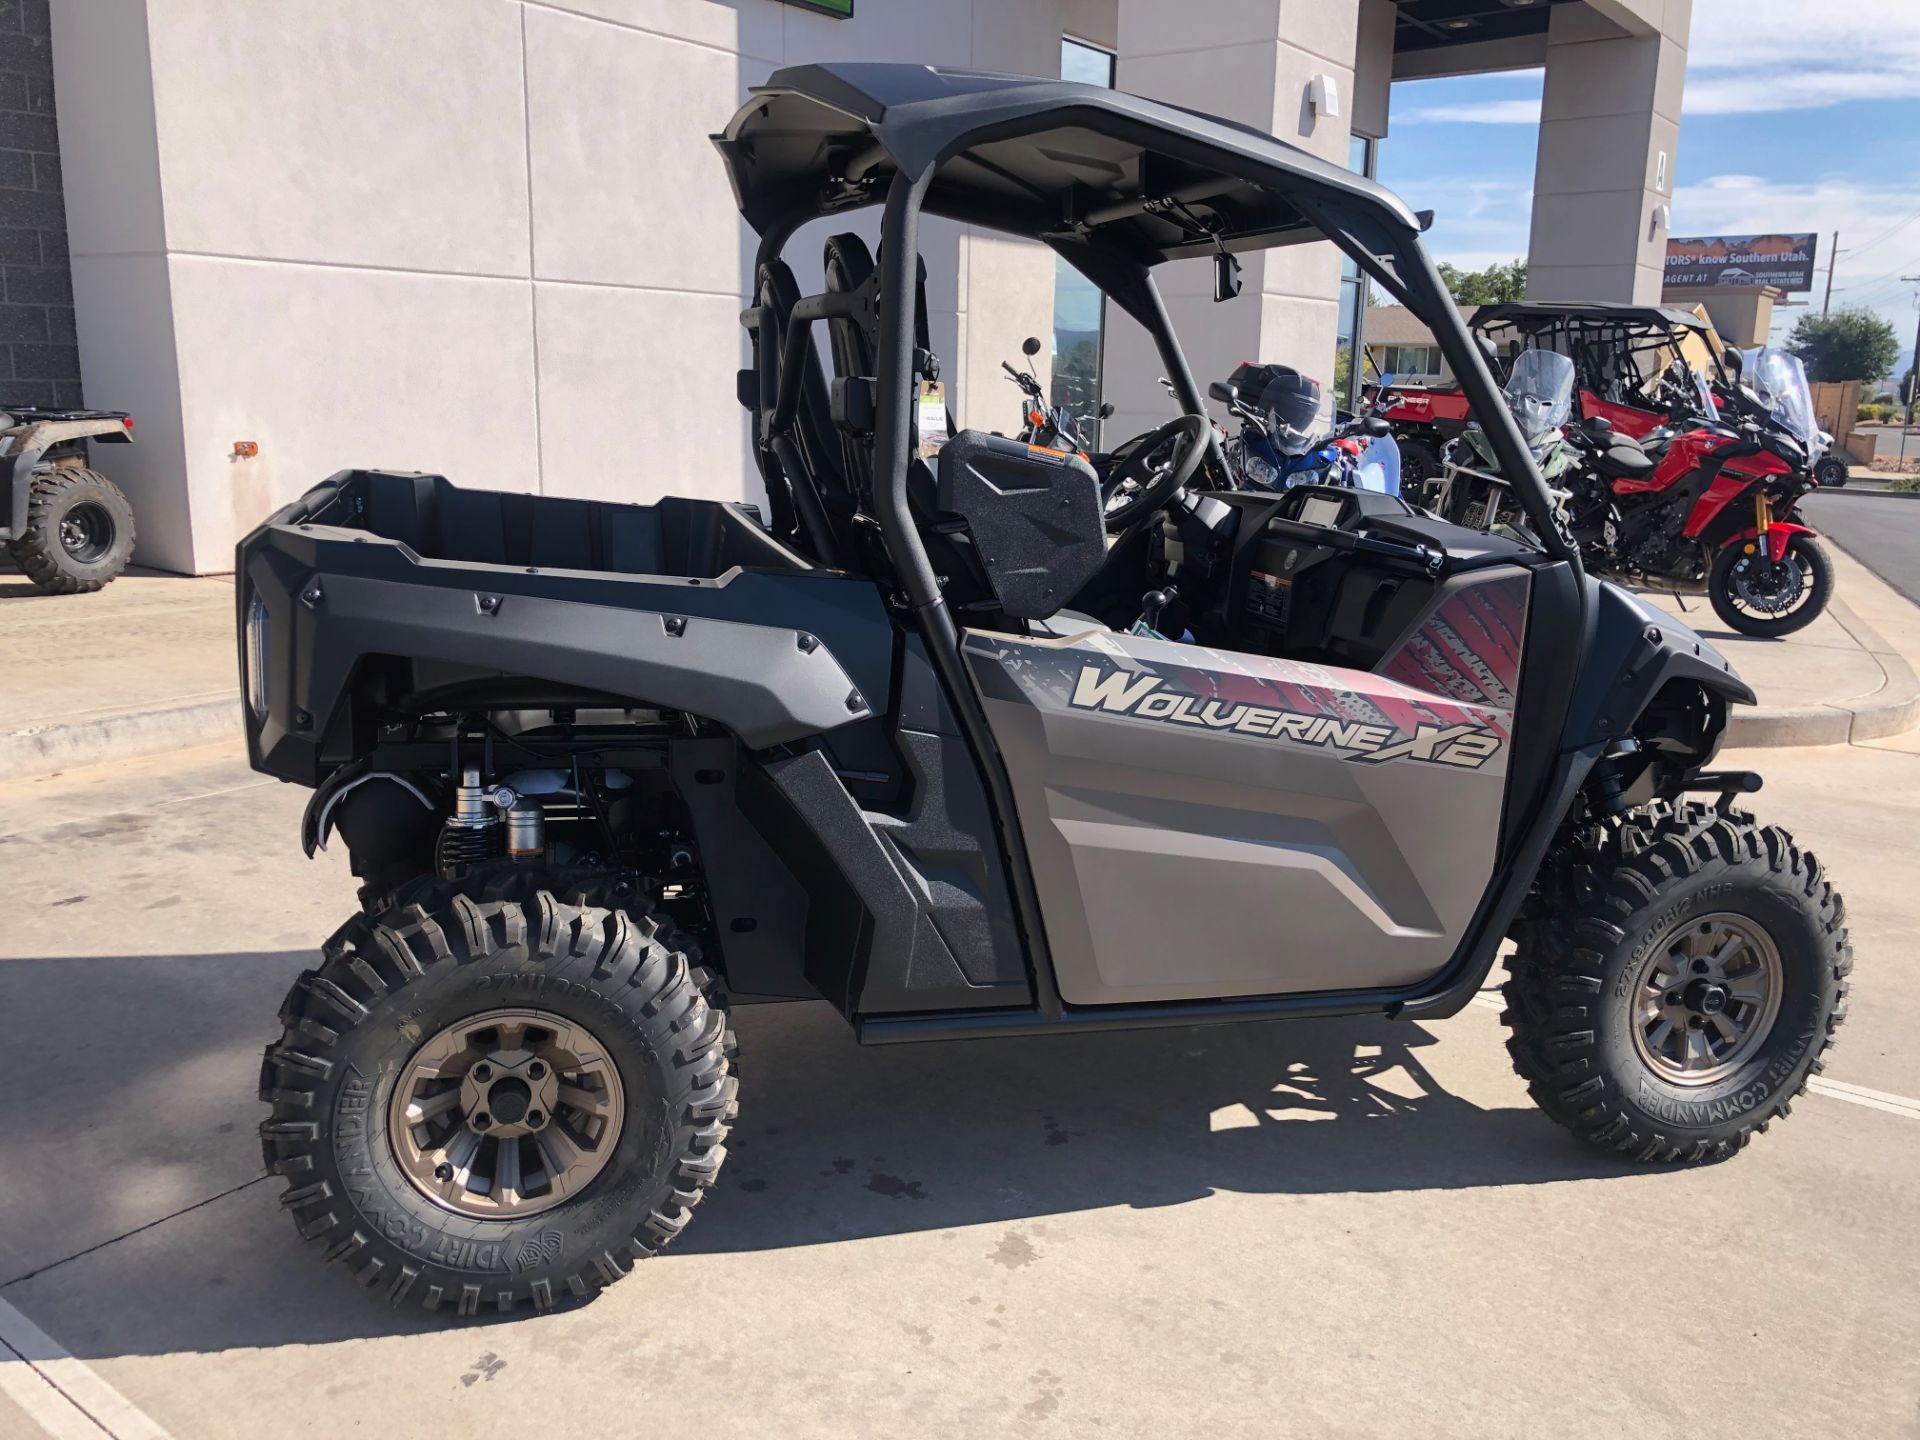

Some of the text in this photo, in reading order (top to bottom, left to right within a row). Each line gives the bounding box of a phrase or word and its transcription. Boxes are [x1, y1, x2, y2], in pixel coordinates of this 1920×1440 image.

[1698, 253, 1728, 264] know
[1729, 251, 1777, 264] Southern
[1780, 250, 1809, 262] Utah.
[1664, 273, 1708, 284] AGENT AT
[1755, 271, 1787, 279] SOUTHERN
[1070, 665, 1502, 769] WOLVERINE X2
[1639, 1081, 1769, 1124] COMMANDER
[428, 1235, 500, 1269] DIRT
